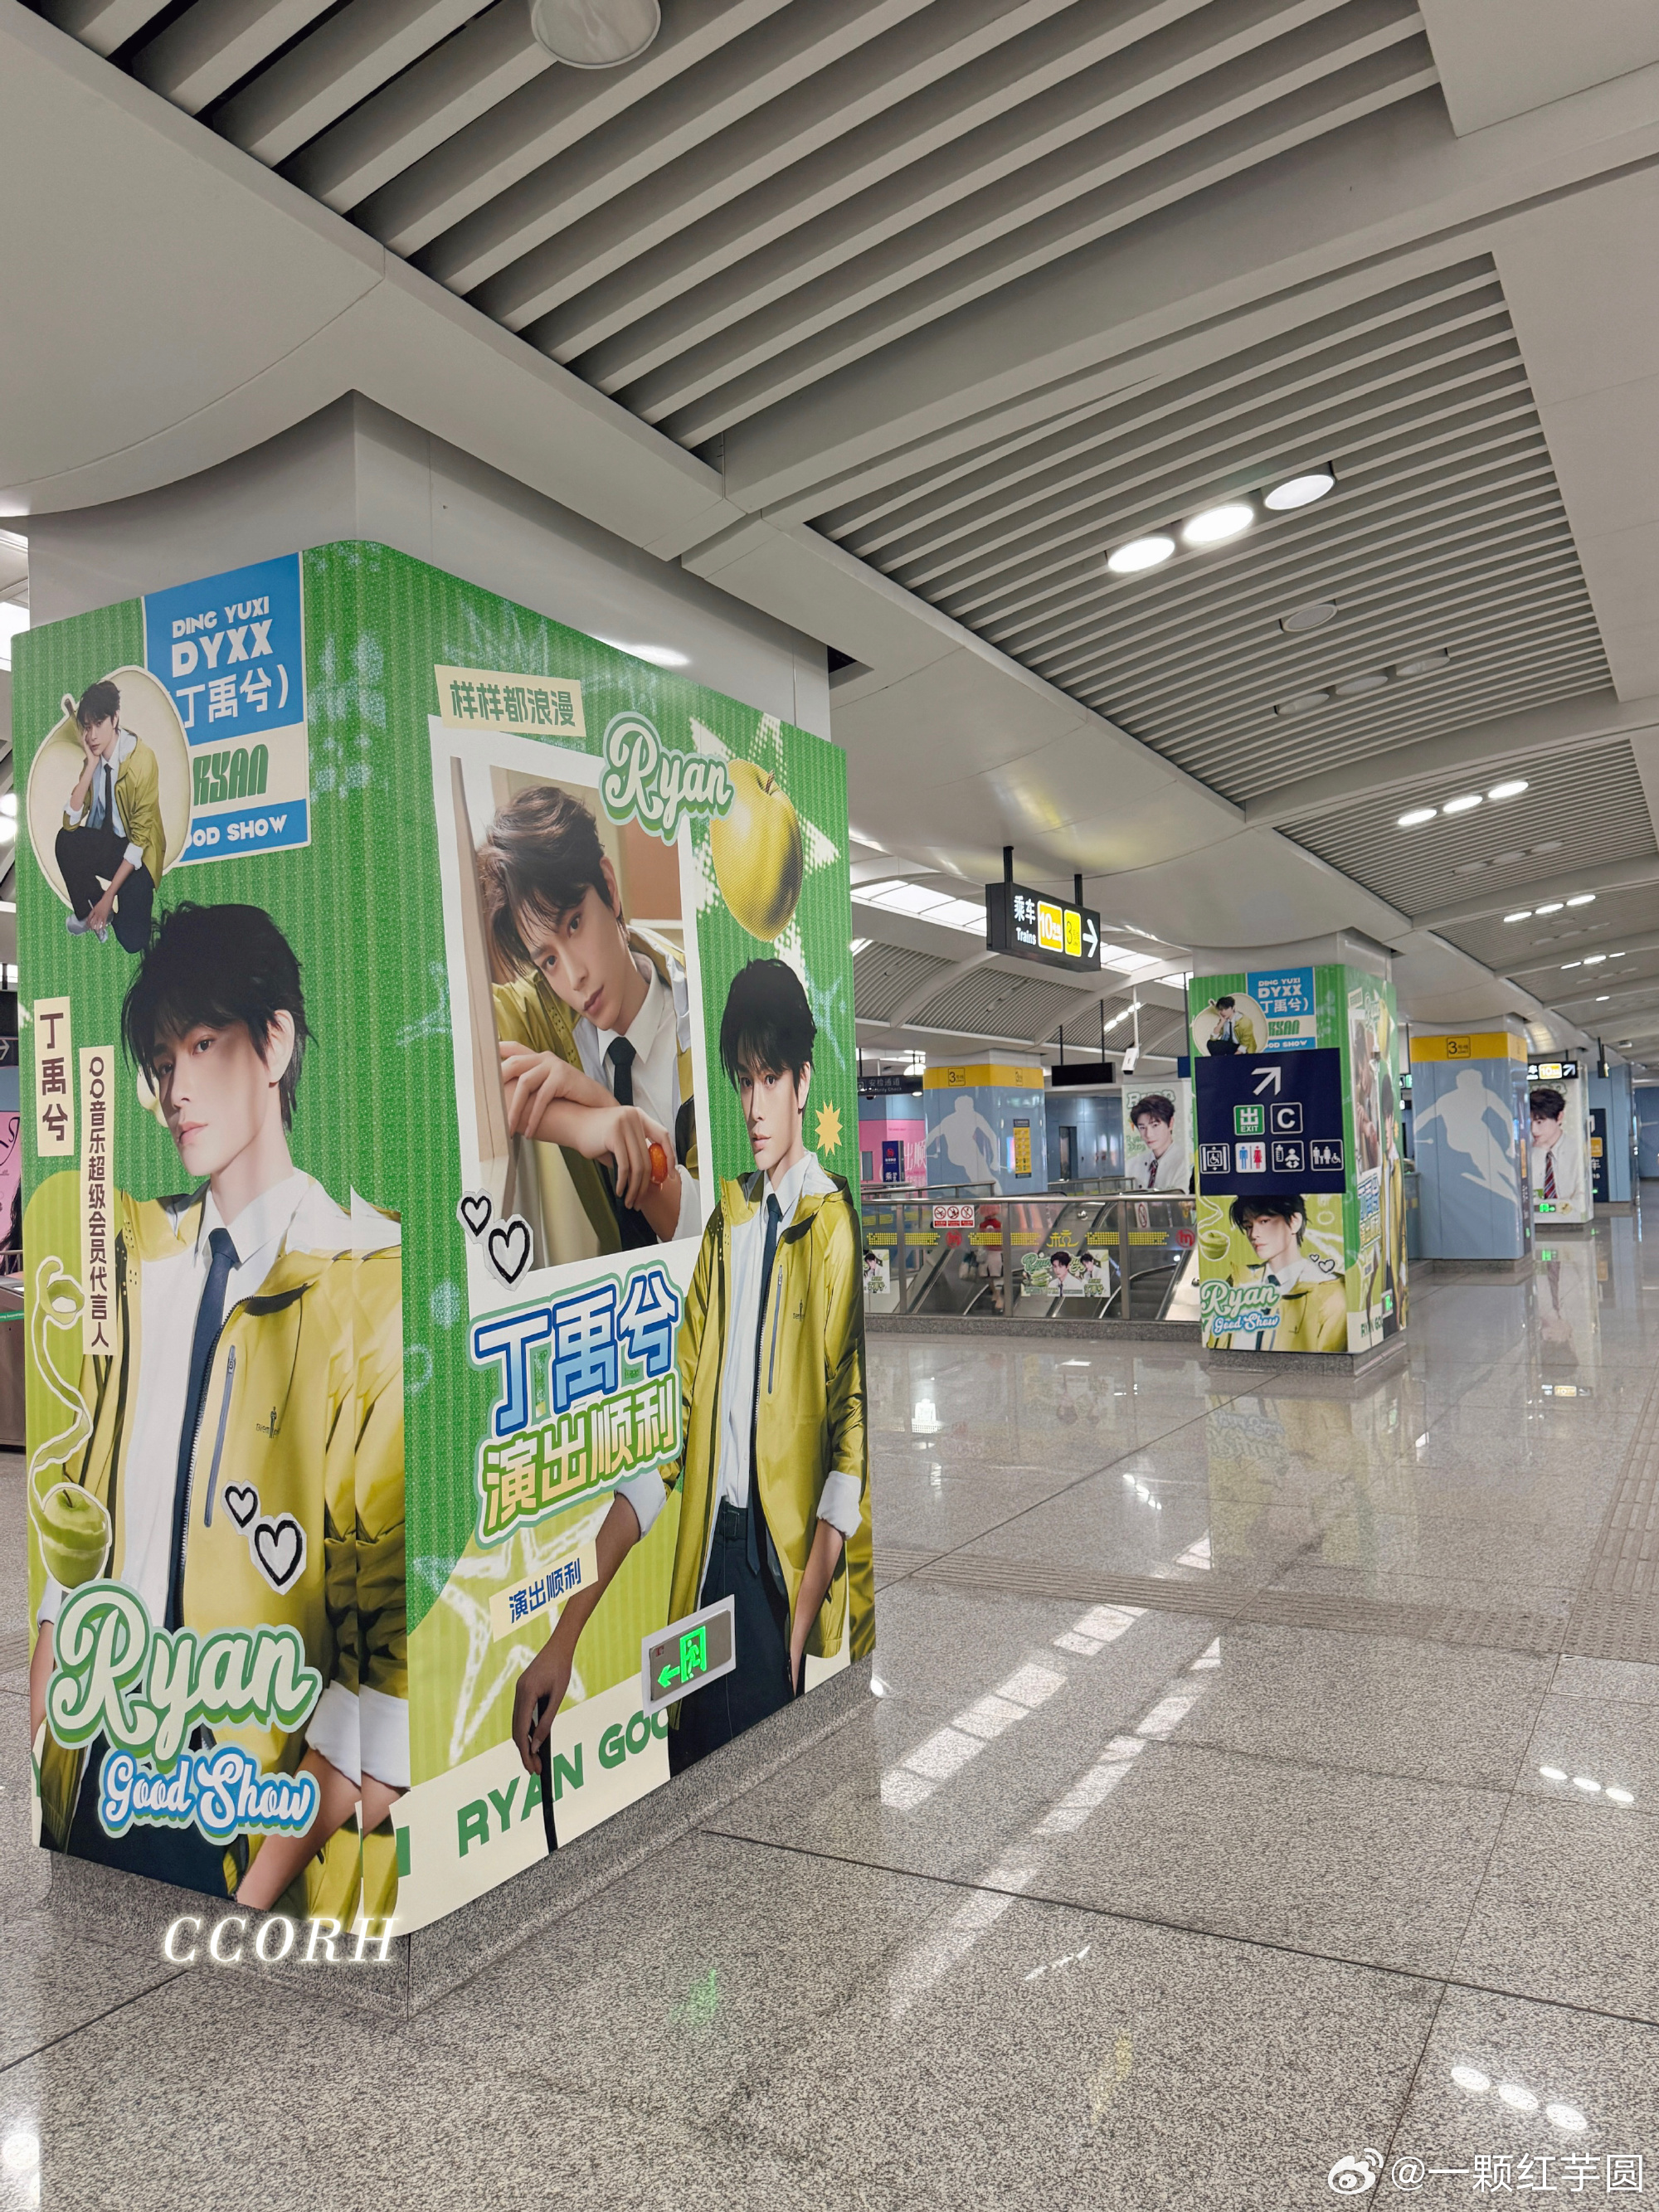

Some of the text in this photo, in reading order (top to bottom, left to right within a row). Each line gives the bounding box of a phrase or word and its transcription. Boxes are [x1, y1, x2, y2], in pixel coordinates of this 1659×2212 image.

[172, 596, 270, 639] DING YUXI
[172, 619, 274, 678] DYXX
[450, 679, 577, 727] 样样都浪漫
[604, 714, 734, 832] Ryan
[226, 814, 288, 841] SHOW
[1014, 895, 1036, 925] 乘车
[1015, 926, 1037, 946] Trains
[1258, 984, 1302, 999] DYXX
[40, 1012, 68, 1141] 丁禹兮
[1239, 1107, 1259, 1125] 出
[1277, 1108, 1296, 1129] C
[89, 1056, 109, 1348] QQ音乐超级会员代言人
[1200, 1280, 1279, 1319] Ryan
[1213, 1312, 1279, 1334] Good Show
[474, 1270, 679, 1436] 丁禹兮
[483, 1374, 679, 1535] 演出顺利
[508, 1557, 581, 1623] 演出顺利
[49, 1586, 318, 1764] Ryan
[105, 1750, 316, 1833] Good Show
